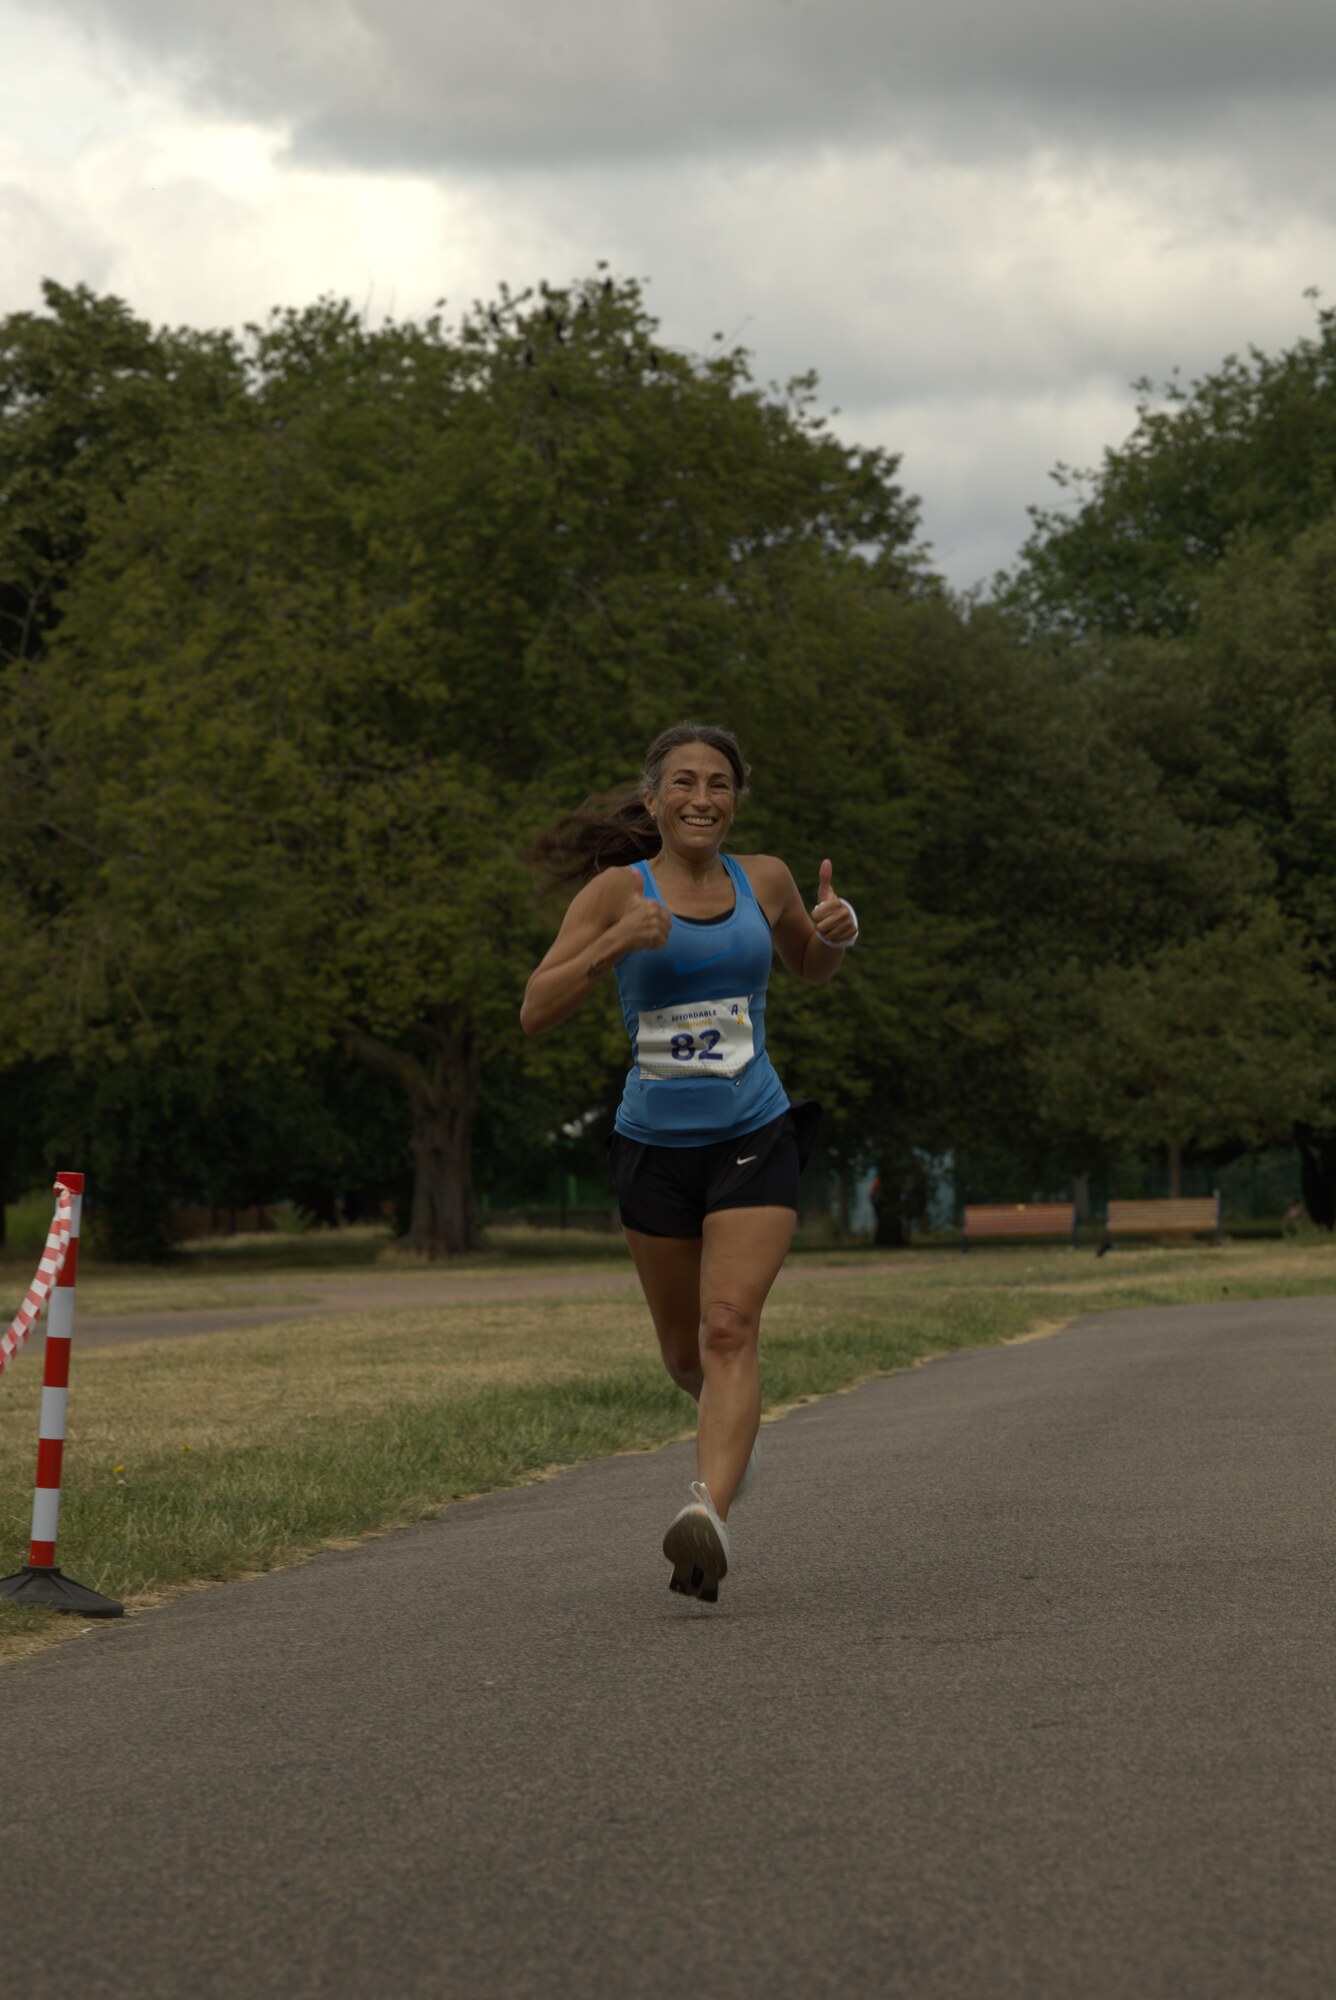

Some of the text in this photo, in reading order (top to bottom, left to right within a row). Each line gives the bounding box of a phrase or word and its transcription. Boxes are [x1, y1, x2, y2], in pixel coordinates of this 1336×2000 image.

[671, 1009, 717, 1022] AFFORDABLE
[731, 1004, 738, 1016] A
[678, 1019, 713, 1029] RUNNING
[737, 1015, 744, 1025] R
[670, 1029, 723, 1061] 82
